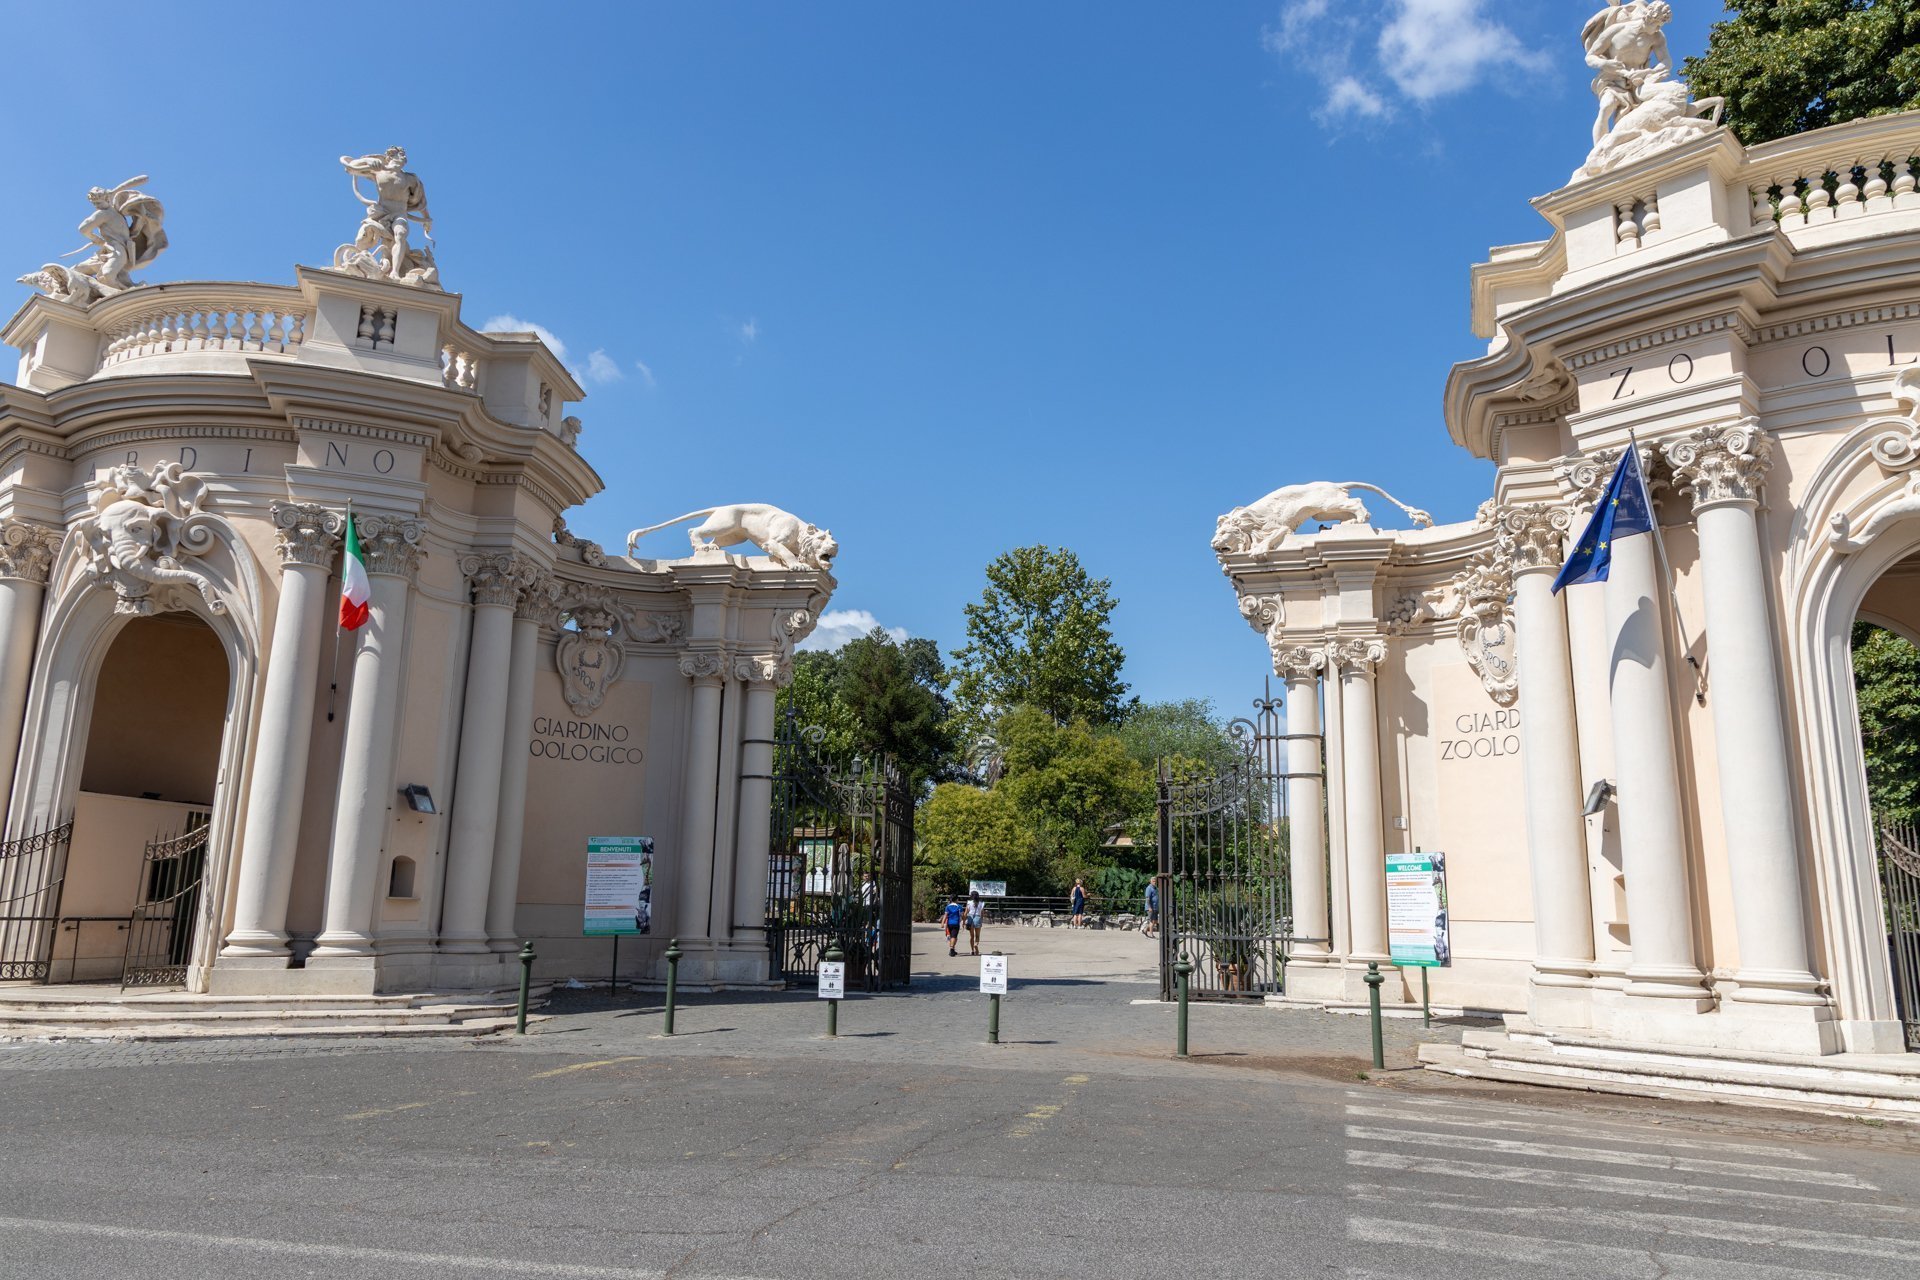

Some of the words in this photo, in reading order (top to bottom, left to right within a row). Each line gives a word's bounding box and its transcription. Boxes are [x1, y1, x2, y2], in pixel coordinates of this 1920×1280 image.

[575, 667, 596, 691] SPQR
[533, 716, 629, 742] GIARDINO
[1455, 708, 1521, 734] GIARD
[1440, 734, 1521, 760] ZOOLO
